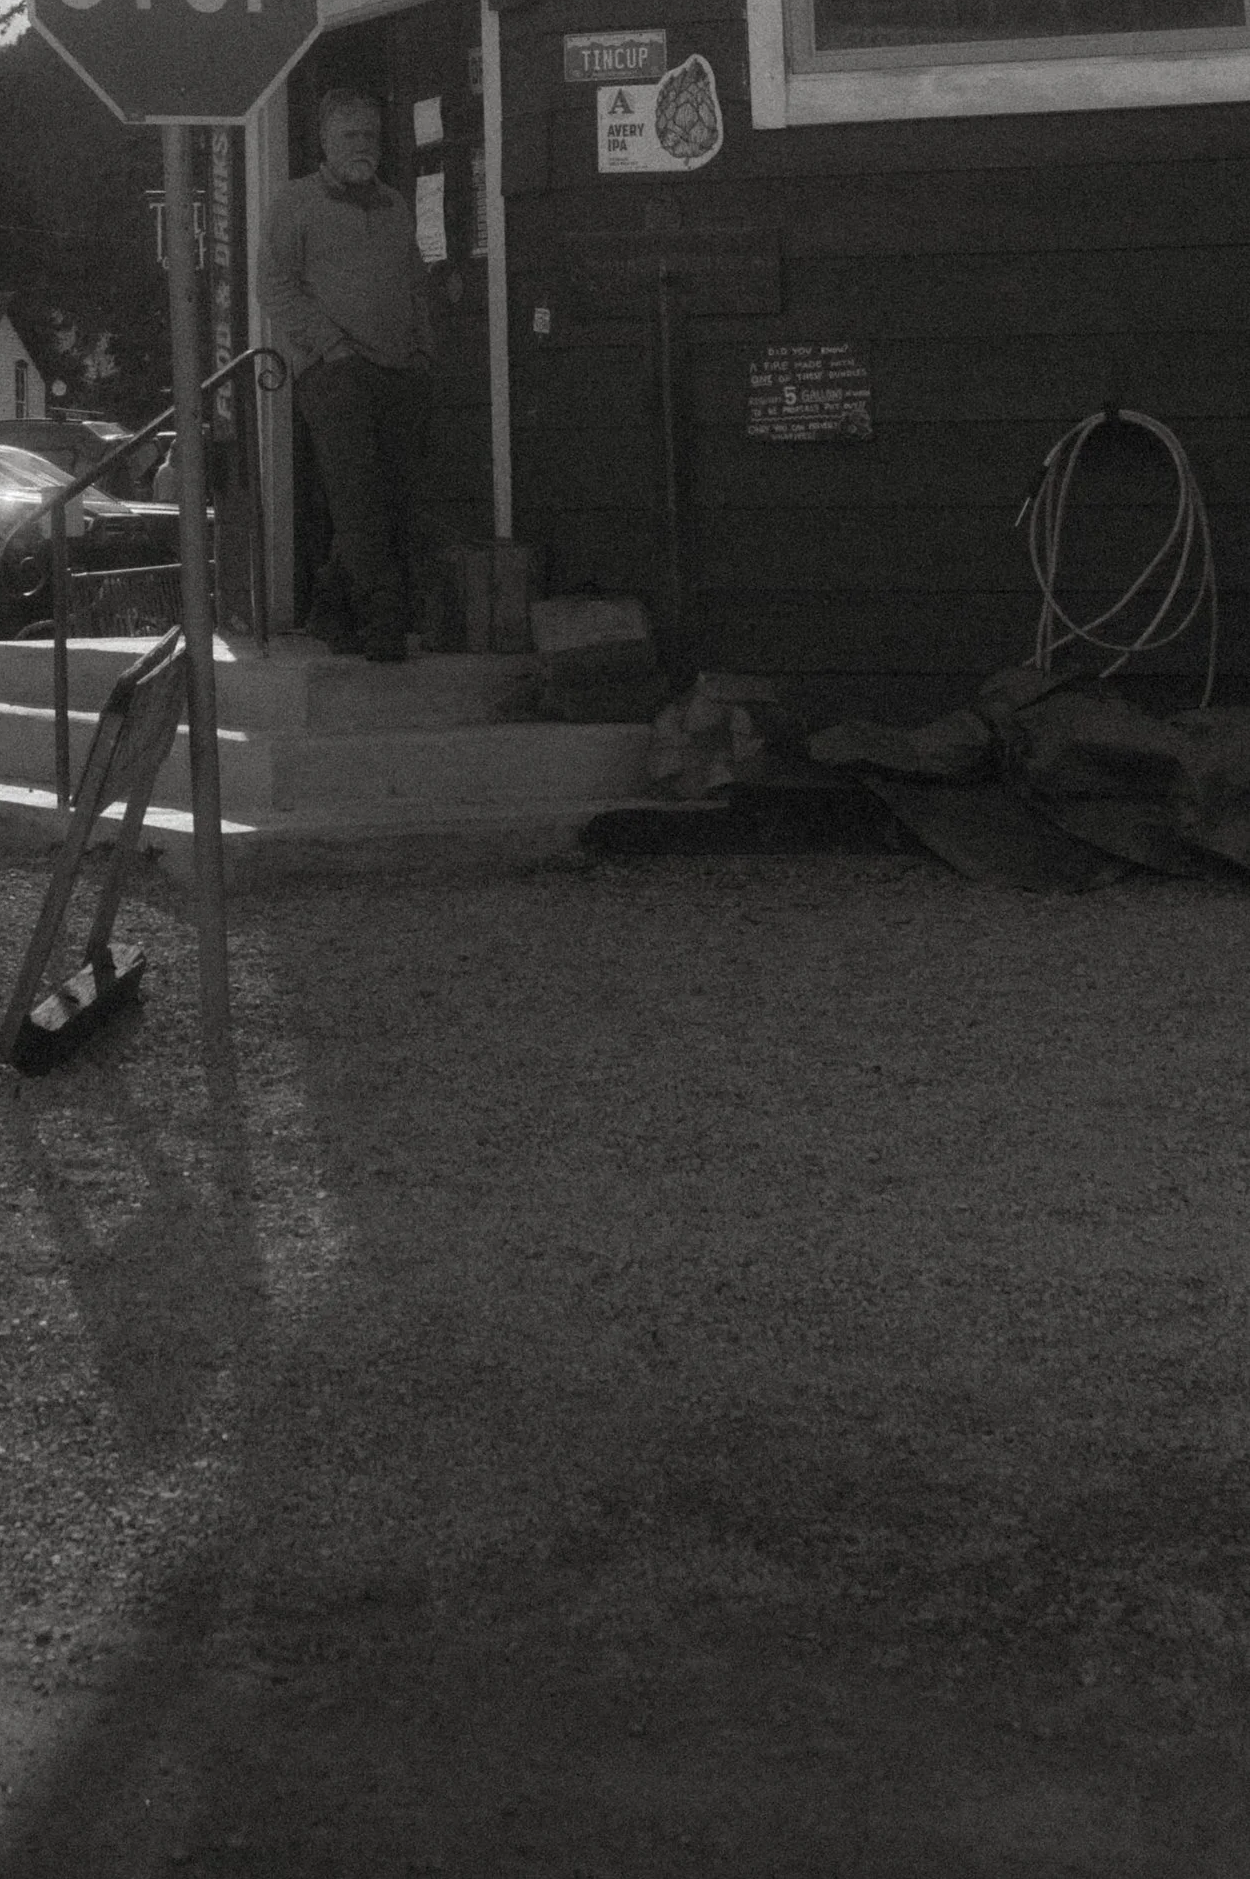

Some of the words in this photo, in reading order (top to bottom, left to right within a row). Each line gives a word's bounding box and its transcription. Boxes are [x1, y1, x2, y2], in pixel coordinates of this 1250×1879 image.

[581, 47, 648, 71] TINCUP
[608, 89, 634, 114] A
[607, 123, 645, 137] AVERY
[607, 139, 628, 152] IPA
[212, 132, 230, 268] DRINKS
[791, 346, 813, 356] YOU
[763, 361, 789, 371] FIRE
[794, 359, 822, 369] MADE
[750, 374, 773, 386] ONE
[782, 385, 798, 406] 5
